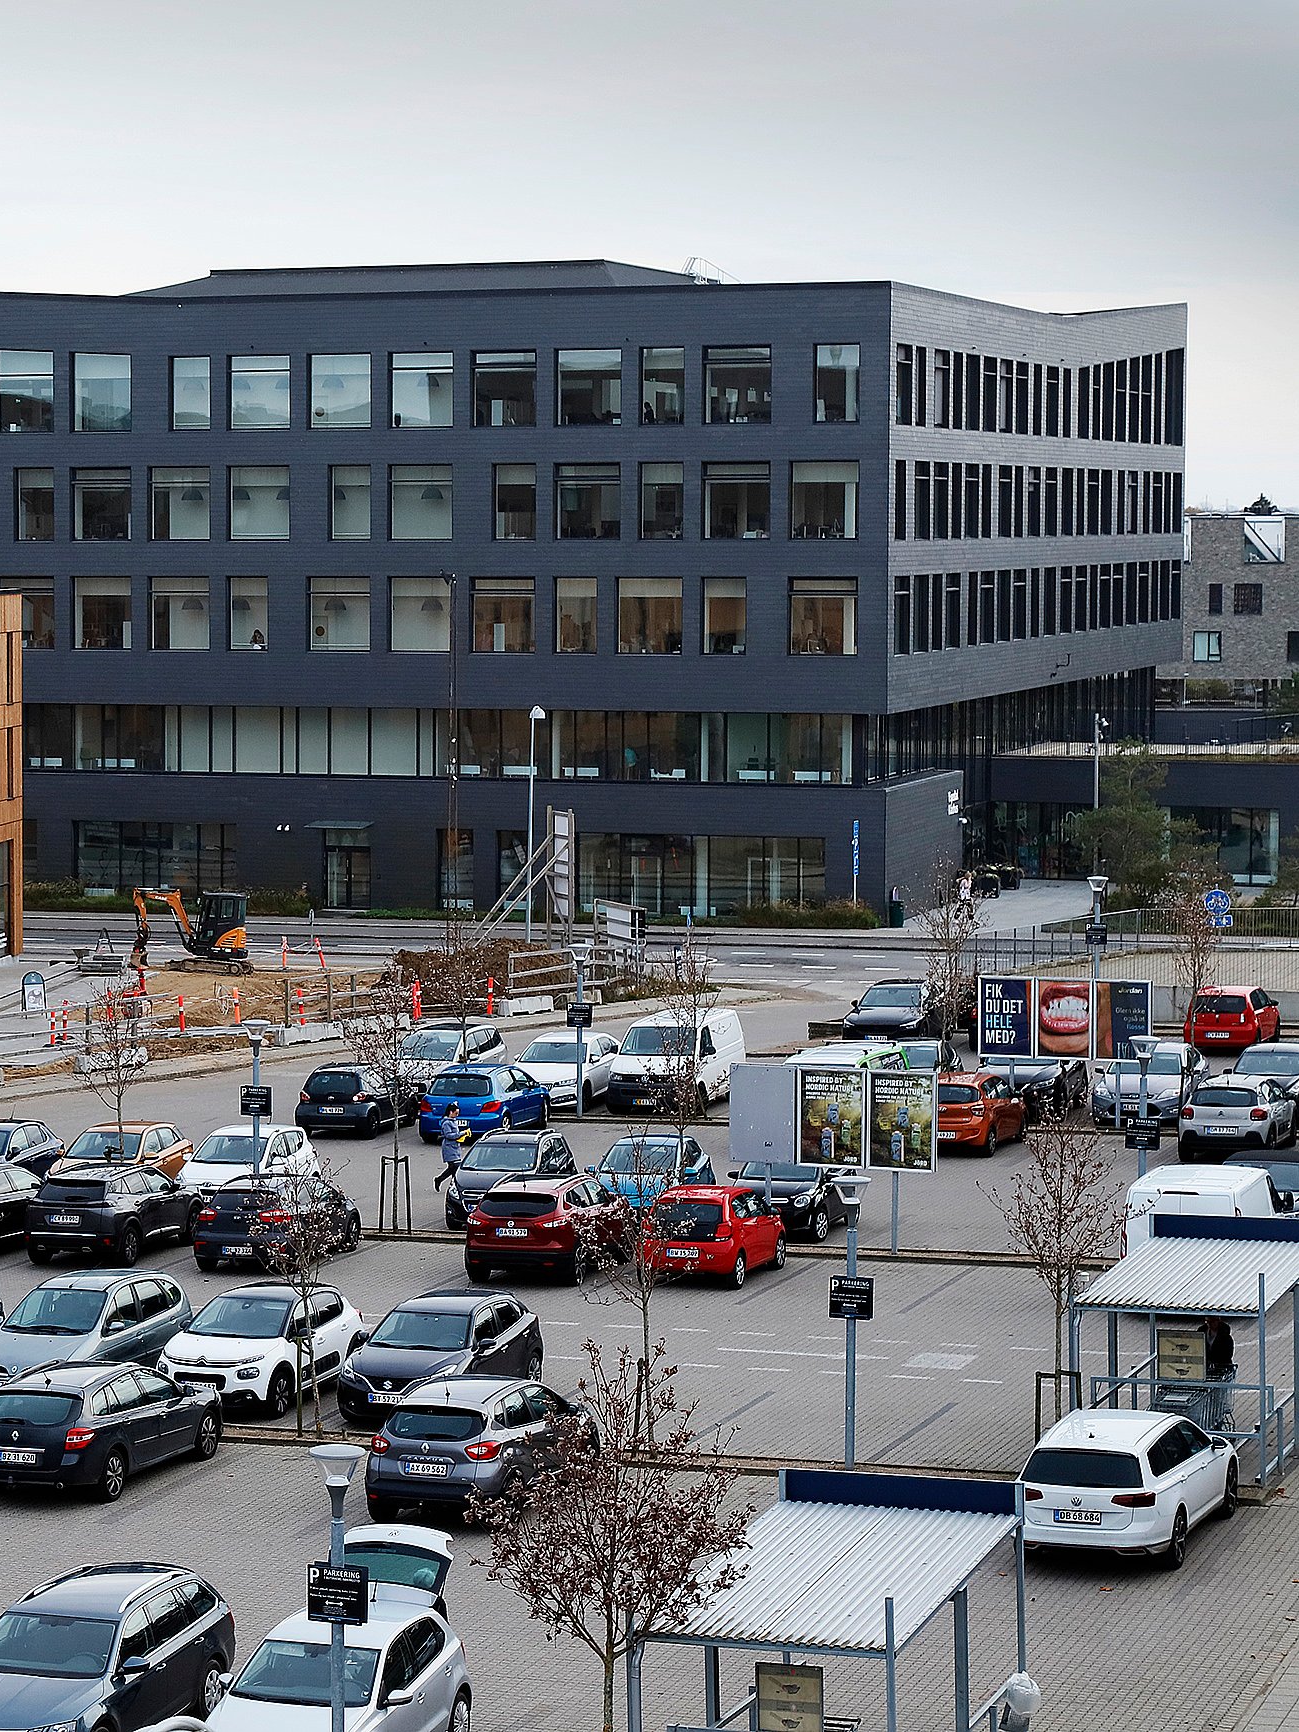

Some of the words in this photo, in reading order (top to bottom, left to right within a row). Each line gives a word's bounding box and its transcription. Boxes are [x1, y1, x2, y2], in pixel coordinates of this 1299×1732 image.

[985, 983, 1003, 998] FIK
[985, 999, 1001, 1014] DU
[1003, 1000, 1023, 1014] DET
[985, 1015, 1013, 1029] HELE
[985, 1029, 1016, 1044] MED?
[805, 1075, 833, 1084] INSPIRED
[875, 1078, 904, 1087] INSPIRED
[805, 1083, 829, 1091] NORDIC
[875, 1086, 899, 1094] NORDIC
[1127, 1118, 1134, 1128] P
[831, 1279, 840, 1291] P
[309, 1567, 320, 1583] P
[323, 1568, 361, 1579] PARKERING
